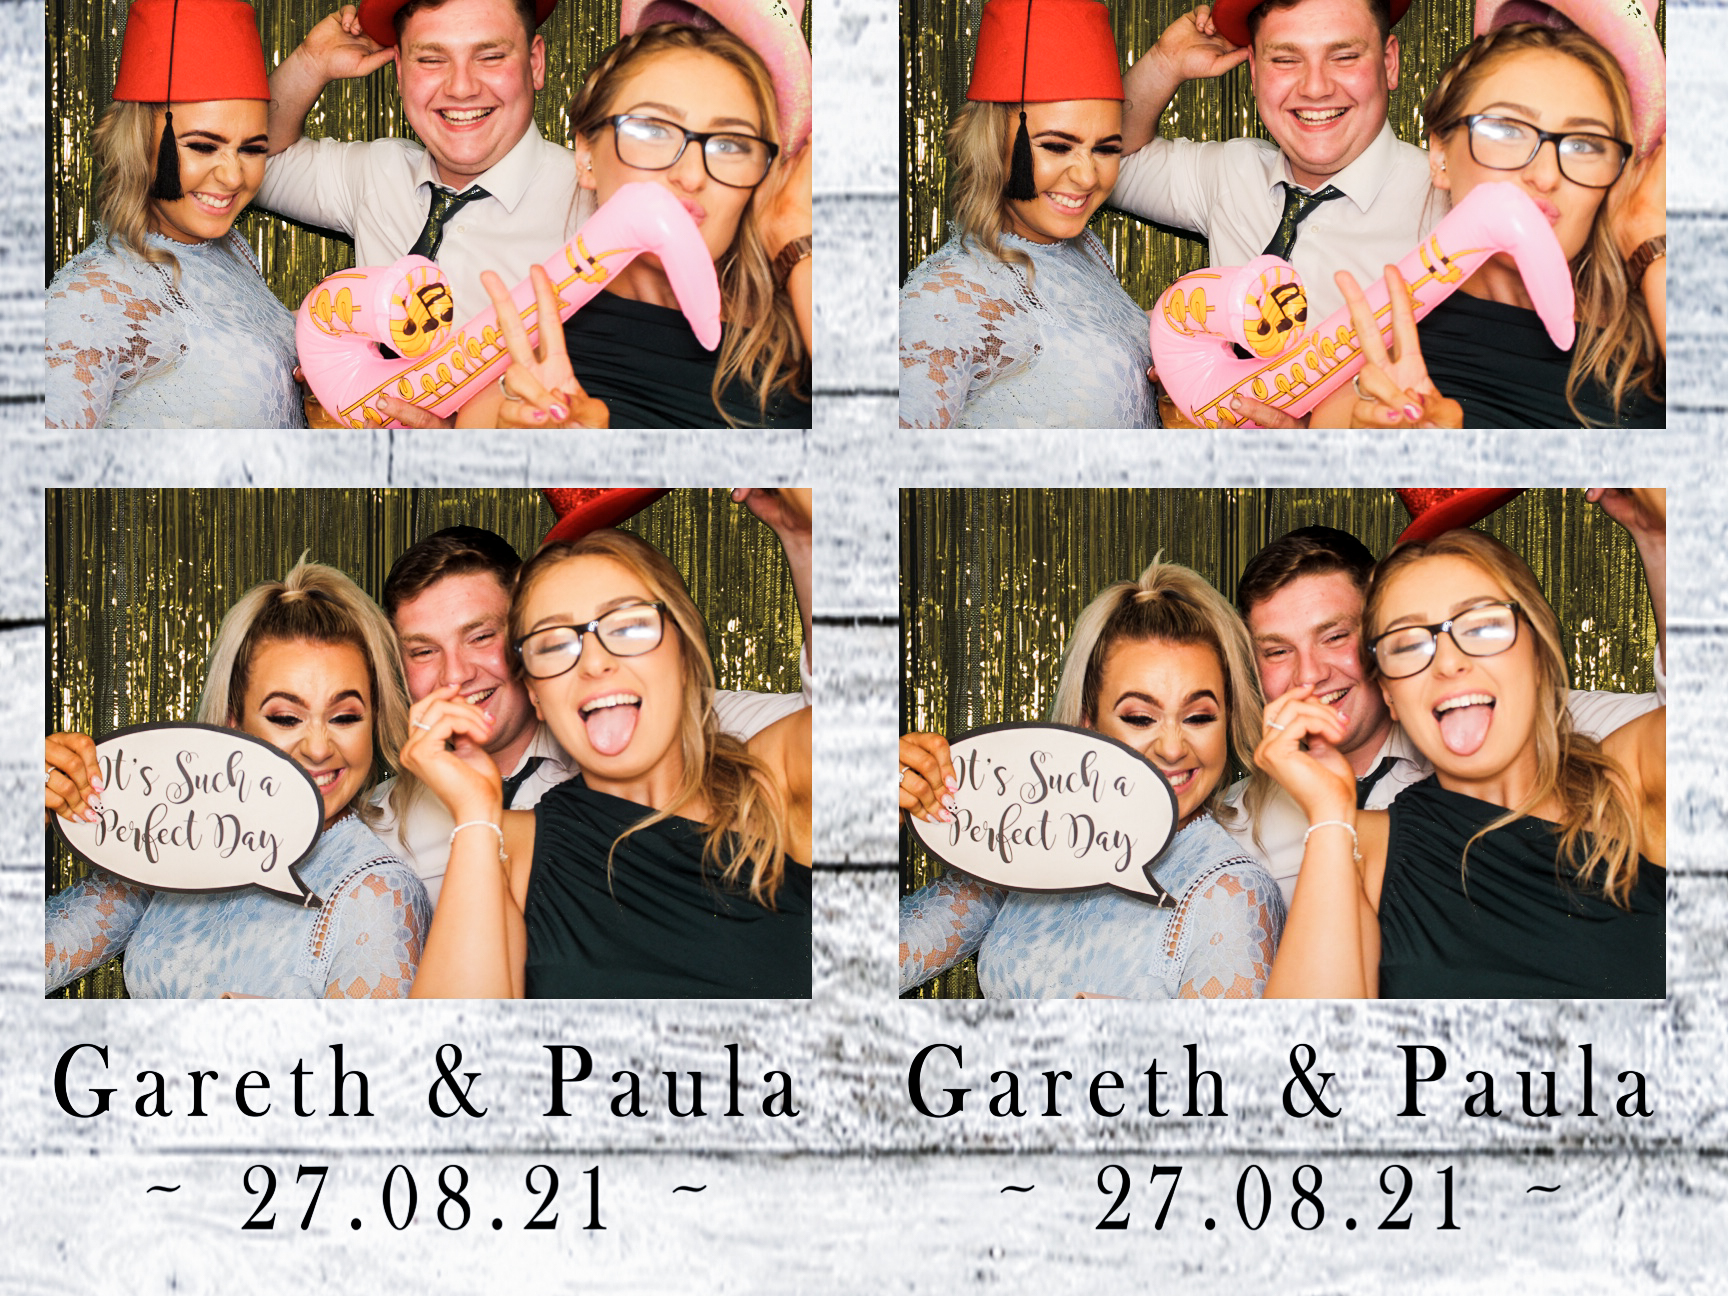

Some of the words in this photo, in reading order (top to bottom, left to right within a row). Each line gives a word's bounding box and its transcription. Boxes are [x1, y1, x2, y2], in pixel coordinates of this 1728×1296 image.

[166, 750, 252, 805] Such
[260, 775, 280, 797] a
[1020, 750, 1106, 805] Such
[1114, 775, 1134, 797] a
[94, 802, 203, 864] Perfect
[206, 813, 284, 873] Day
[948, 802, 1057, 864] Perfect
[1060, 813, 1138, 873] Day
